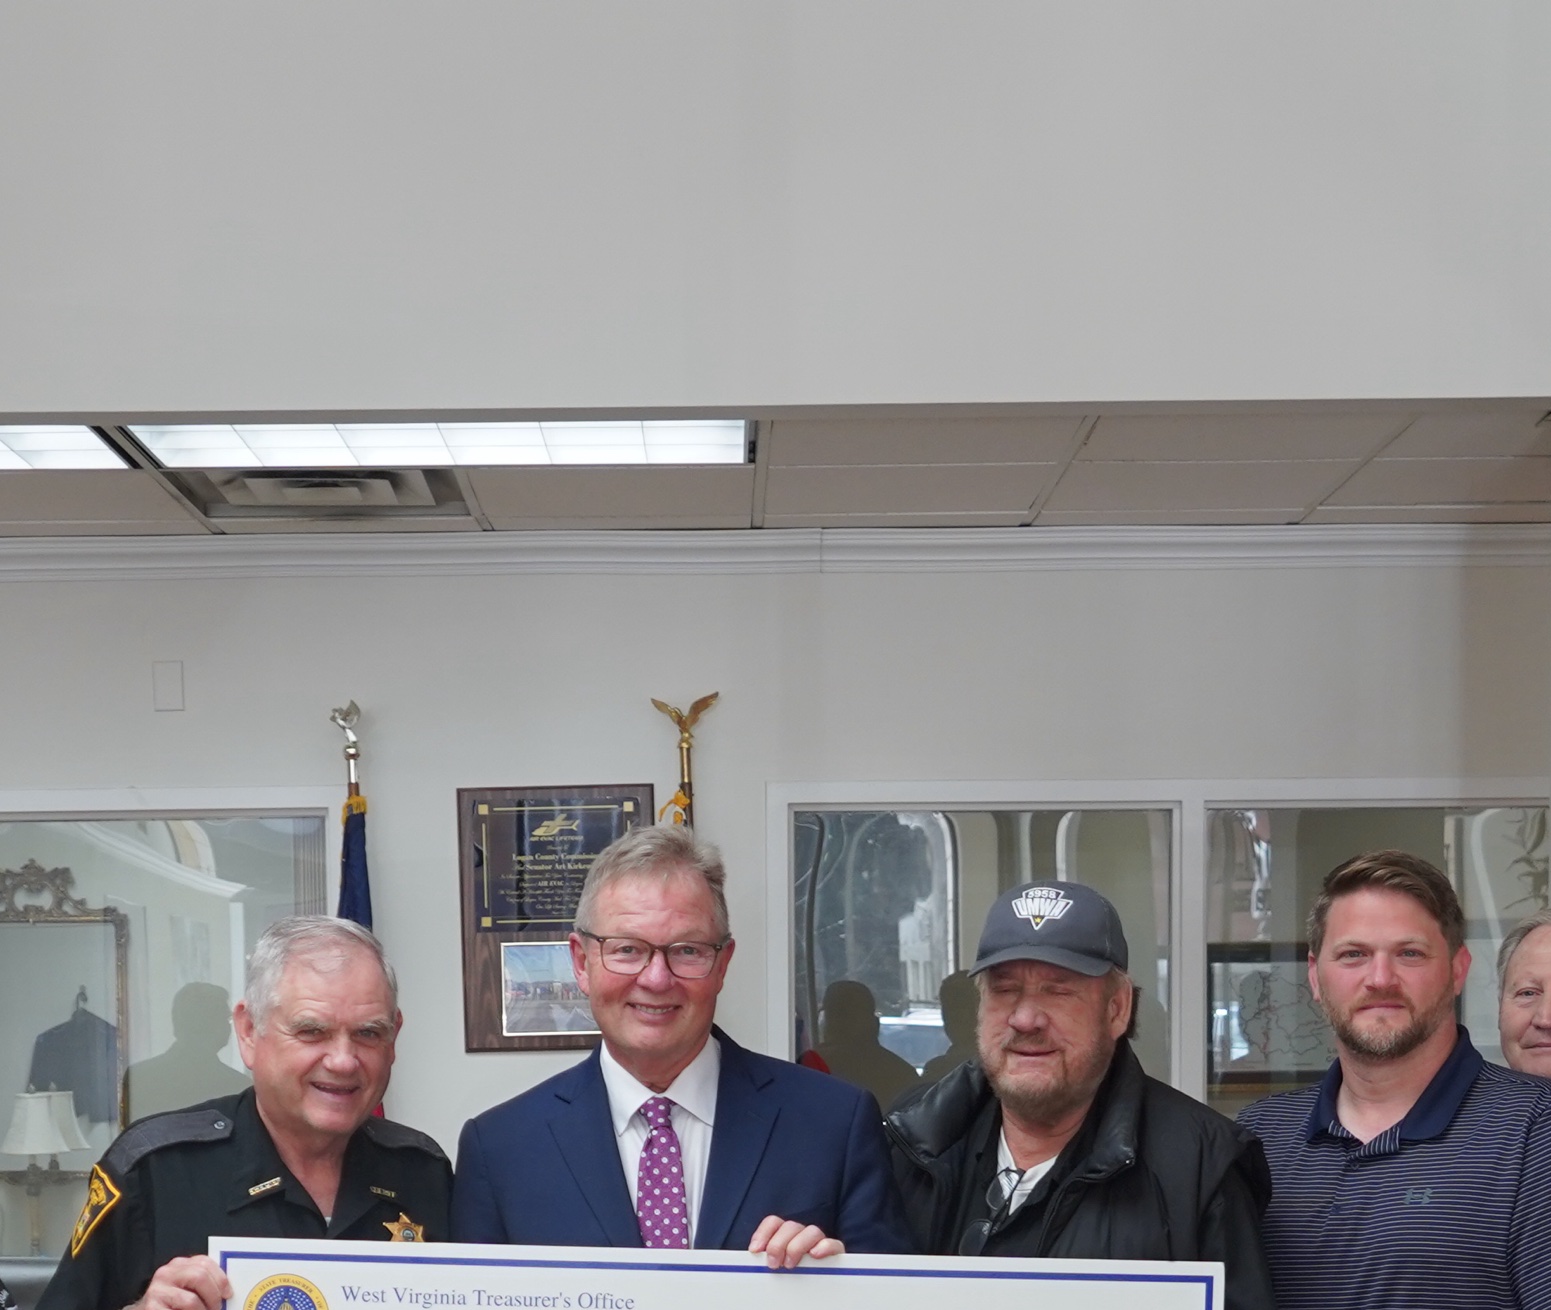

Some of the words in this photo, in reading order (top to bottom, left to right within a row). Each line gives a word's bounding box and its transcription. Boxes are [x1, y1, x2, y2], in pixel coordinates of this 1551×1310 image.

[341, 1285, 386, 1304] West
[392, 1287, 467, 1309] Virginia
[472, 1290, 572, 1309] Treasurer's
[577, 1292, 635, 1310] Office
